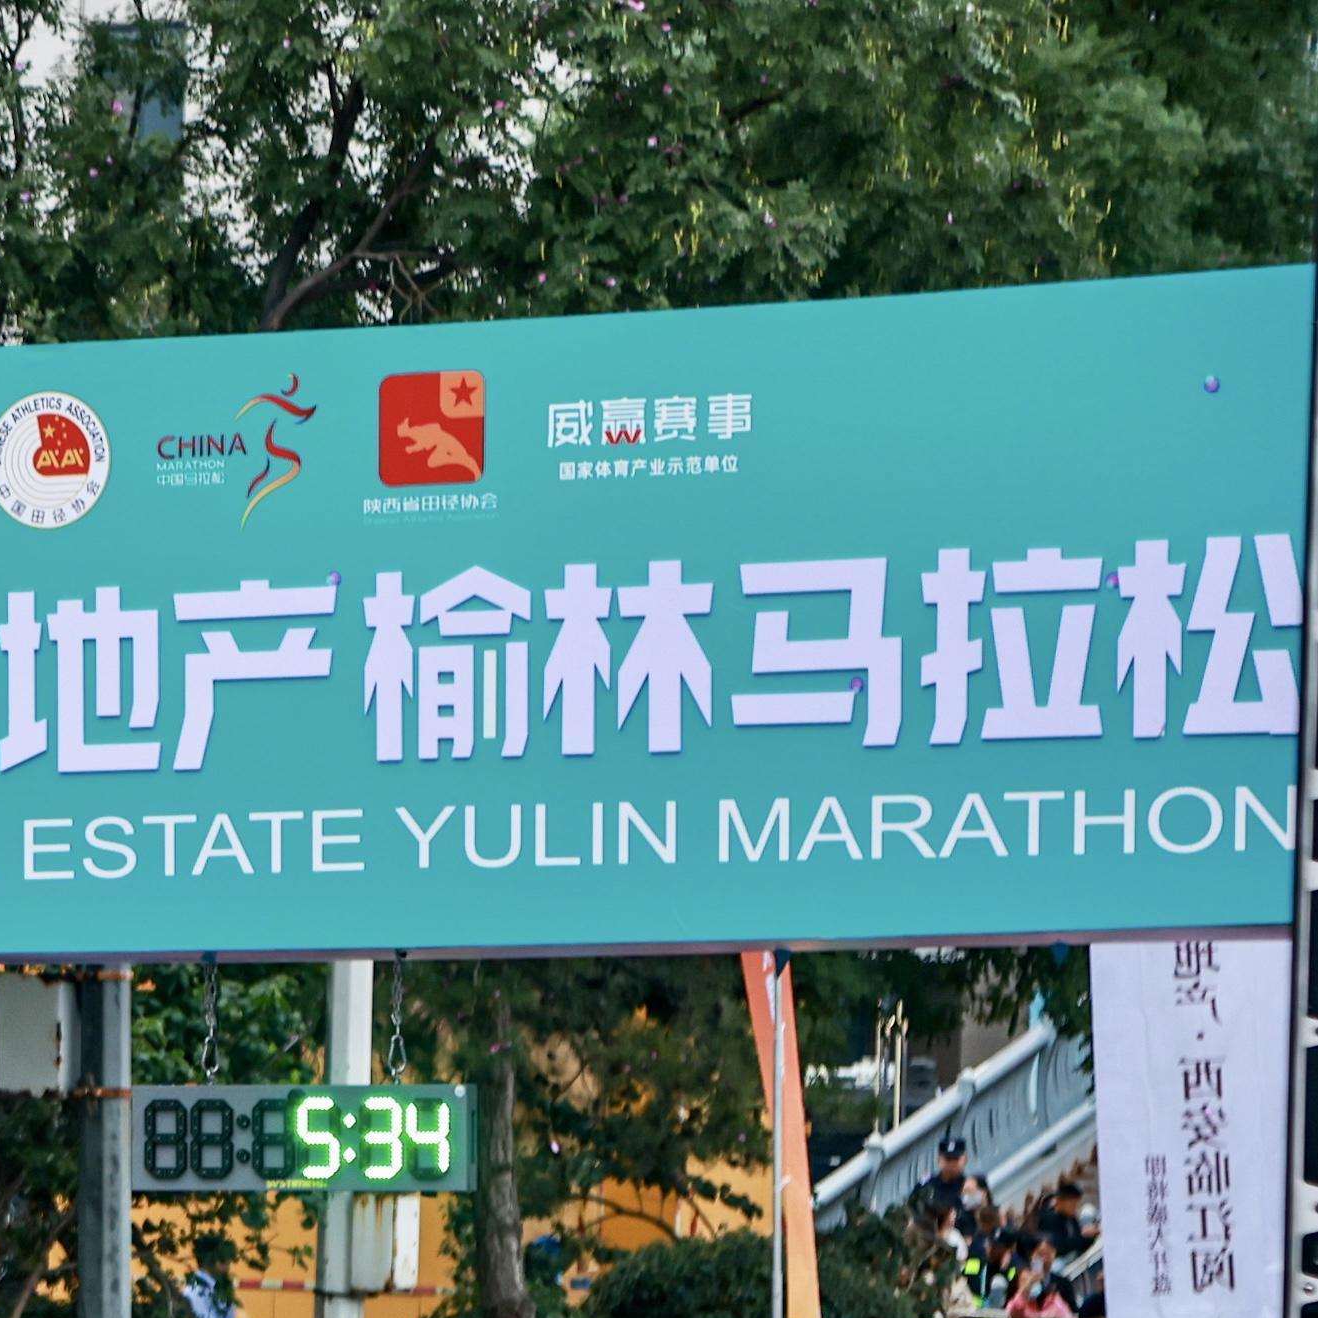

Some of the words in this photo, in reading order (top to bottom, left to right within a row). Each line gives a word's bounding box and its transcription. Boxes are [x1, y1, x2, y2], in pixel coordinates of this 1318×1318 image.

[11, 396, 62, 424] ATHLETICS
[65, 402, 105, 463] ASSOCIATION
[547, 393, 753, 448] 威赢赛事
[156, 460, 225, 472] MARATHON
[157, 432, 247, 460] CHINA
[559, 454, 739, 481] 国家体育产业示范单位
[362, 492, 498, 515] 陕西省田径协会
[21, 808, 365, 882] ESTATE
[395, 800, 679, 870] YULIN
[717, 784, 1299, 863] MARATHON
[296, 1095, 450, 1180] 5:34
